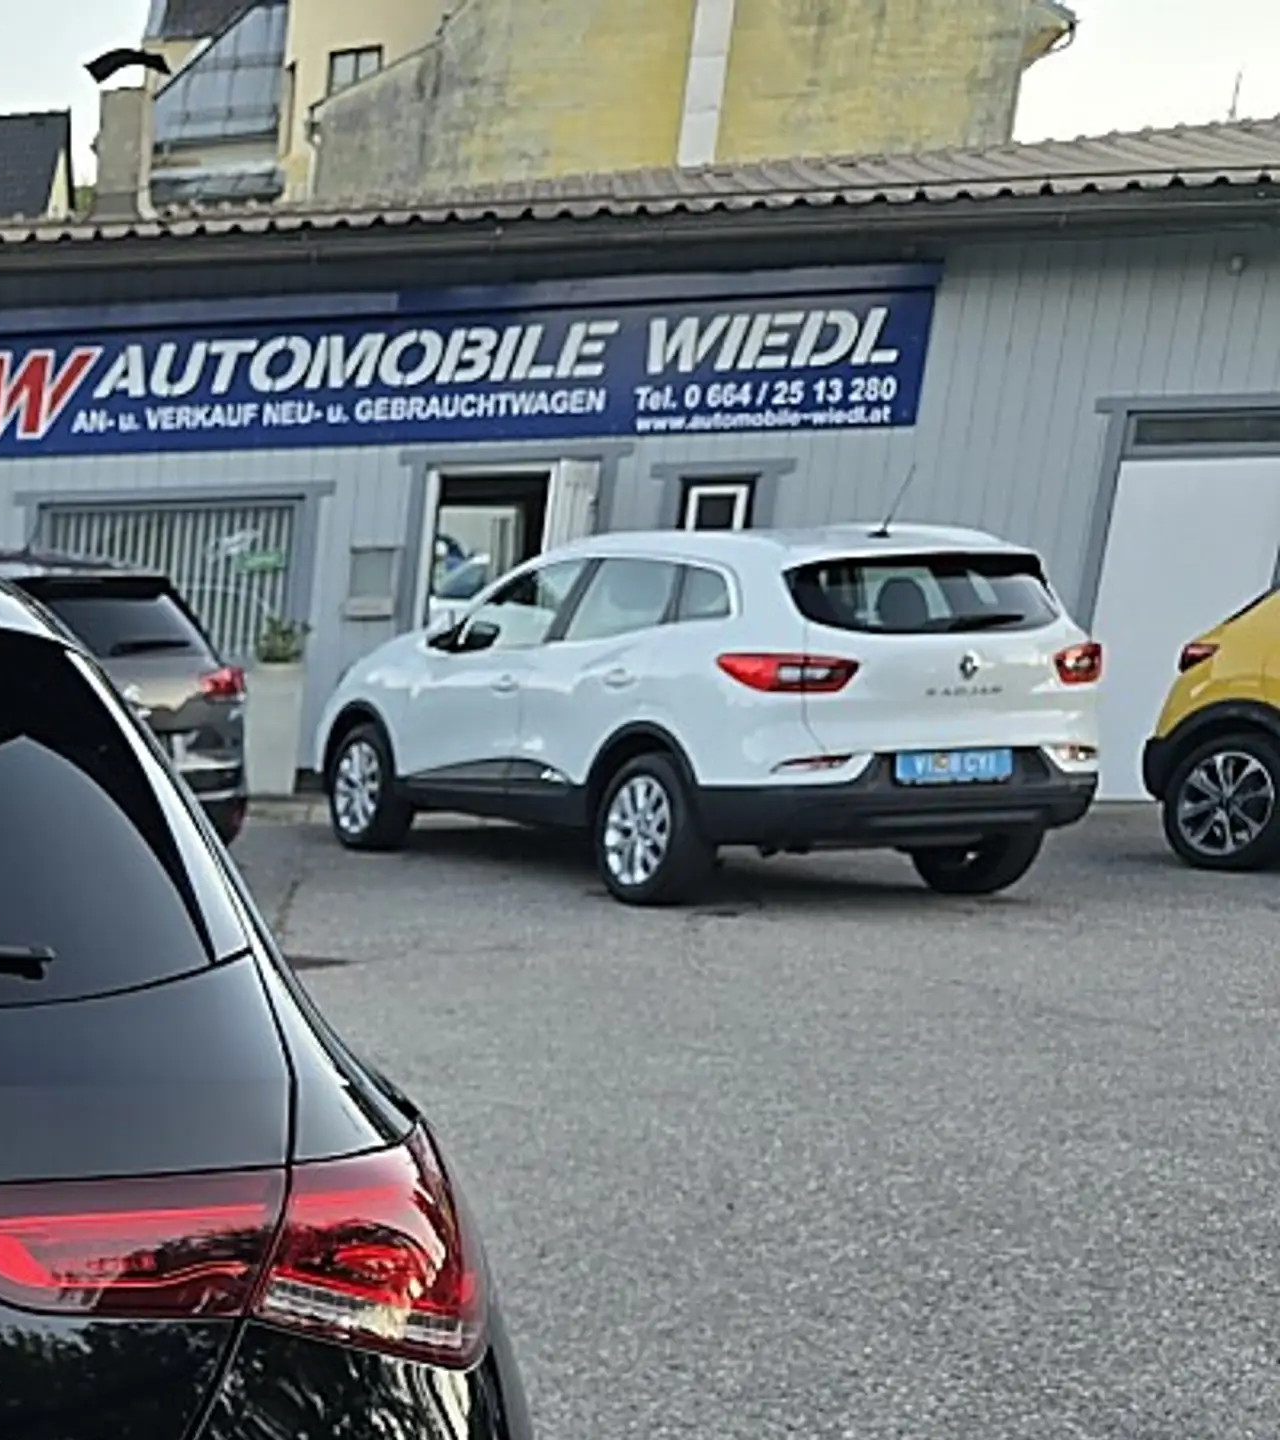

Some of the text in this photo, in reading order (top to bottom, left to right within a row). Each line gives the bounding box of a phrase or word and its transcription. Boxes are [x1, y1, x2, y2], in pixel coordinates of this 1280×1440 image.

[93, 320, 619, 399] AUTOMOBILE
[646, 306, 900, 375] WIEDL
[72, 388, 606, 433] AN- u. VERKAUF NEU- u. GEBRAUCHTWAGEN
[635, 385, 677, 411] Tel.
[684, 384, 701, 408] 0
[706, 380, 752, 407] 664
[771, 378, 805, 404] 25
[812, 378, 844, 403] 13
[848, 375, 897, 402] 280
[636, 405, 891, 431] www.automobile-wiedl.at
